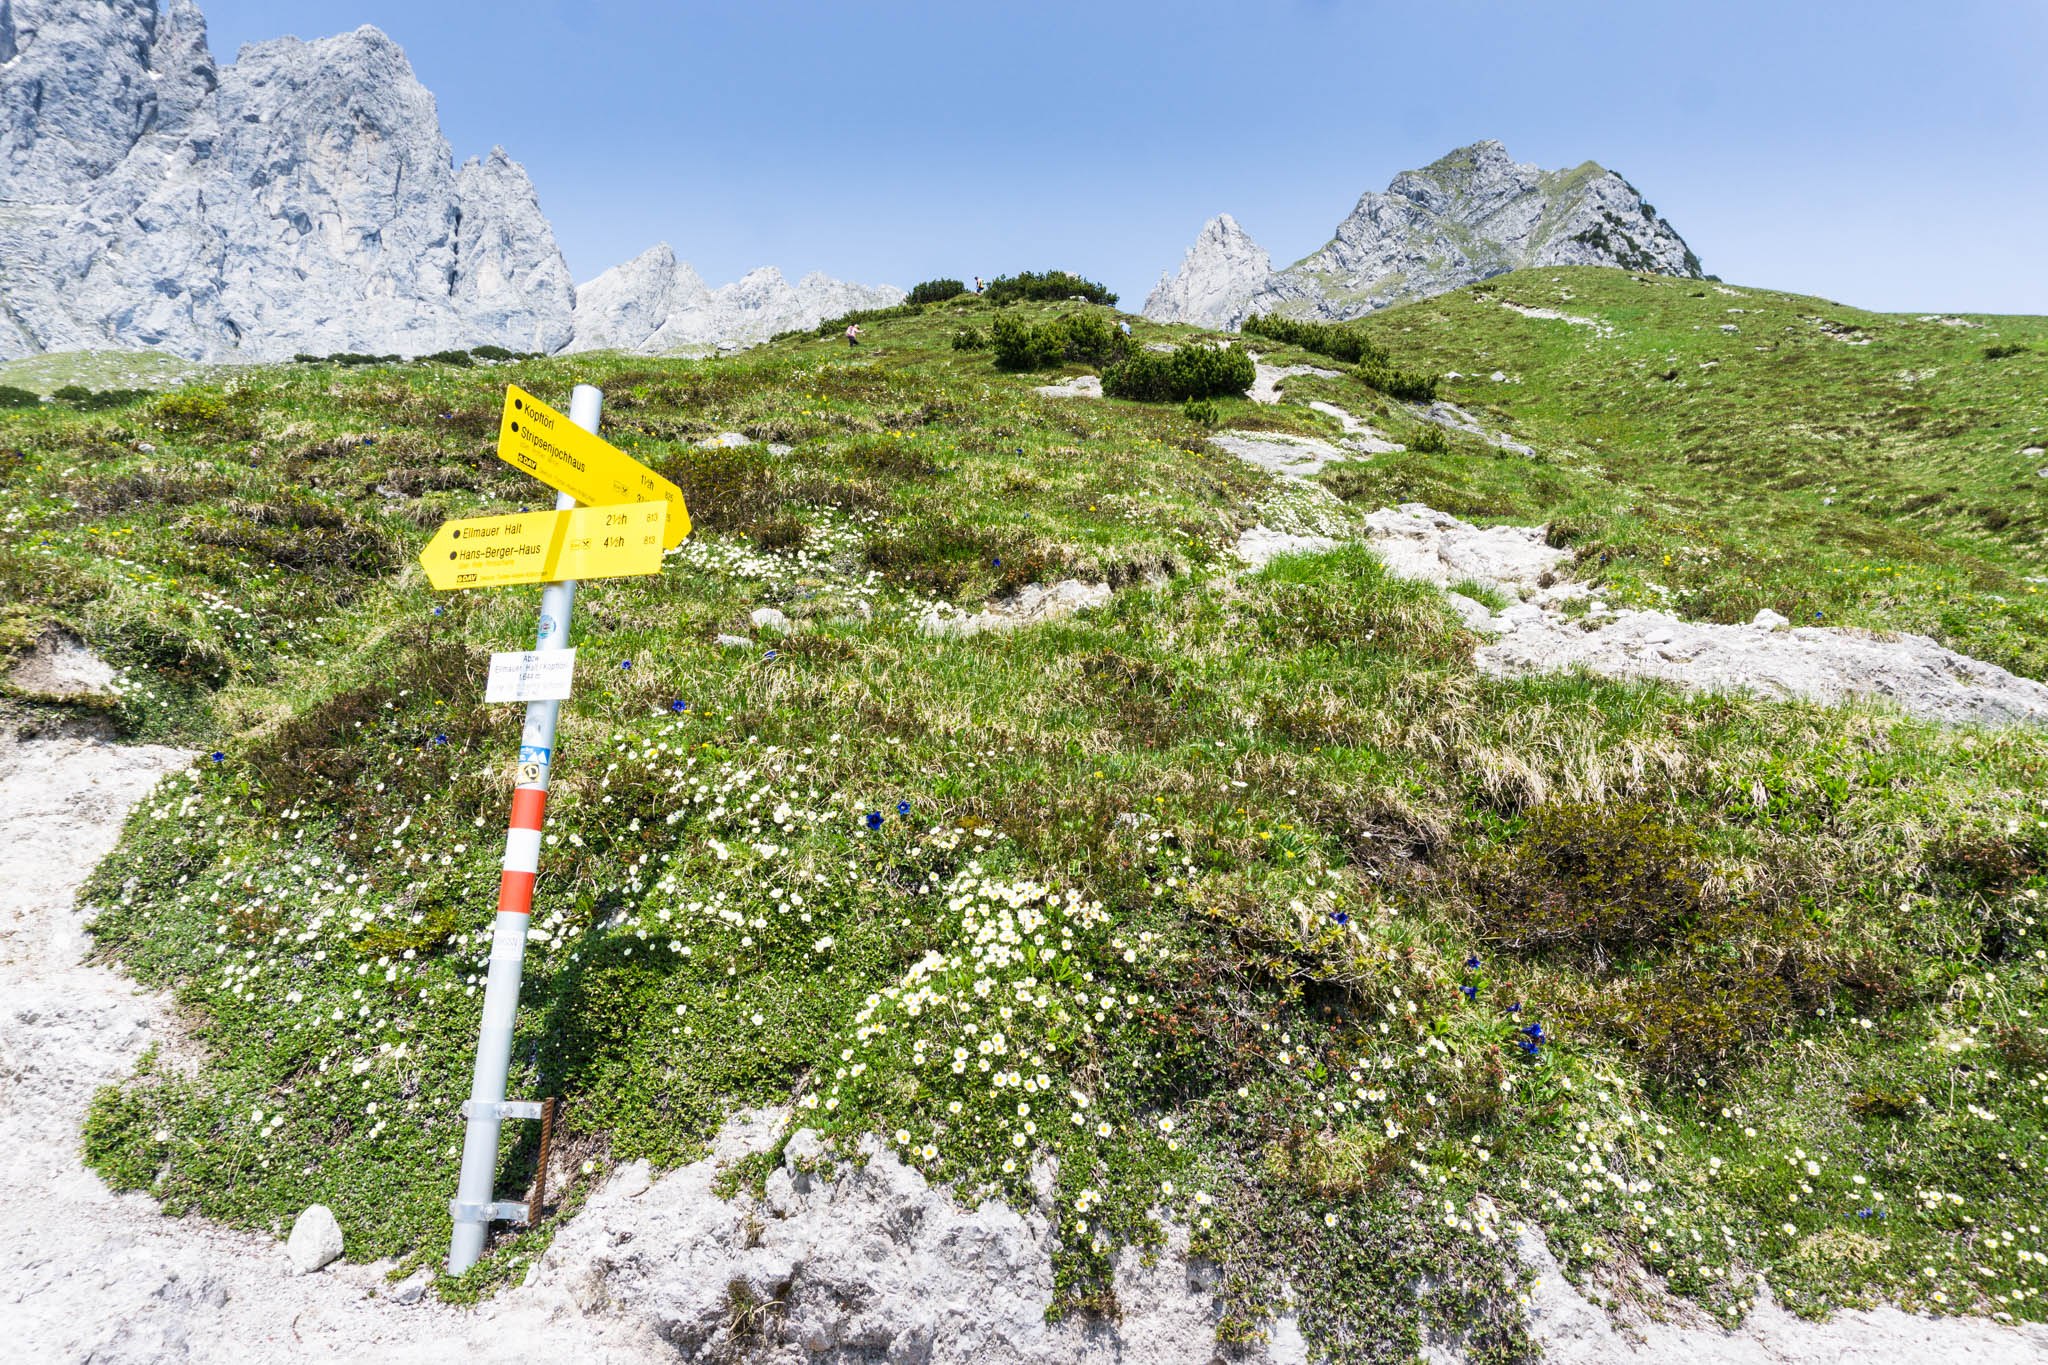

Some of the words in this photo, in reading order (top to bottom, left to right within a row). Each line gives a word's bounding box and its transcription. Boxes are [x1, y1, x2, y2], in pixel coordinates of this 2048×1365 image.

[524, 403, 555, 431] Kopftörl
[520, 426, 586, 473] Stripsenjochhaus
[462, 526, 500, 539] Ellmauer
[504, 523, 522, 535] Halt
[459, 543, 541, 560] Hans-Berger-Haus
